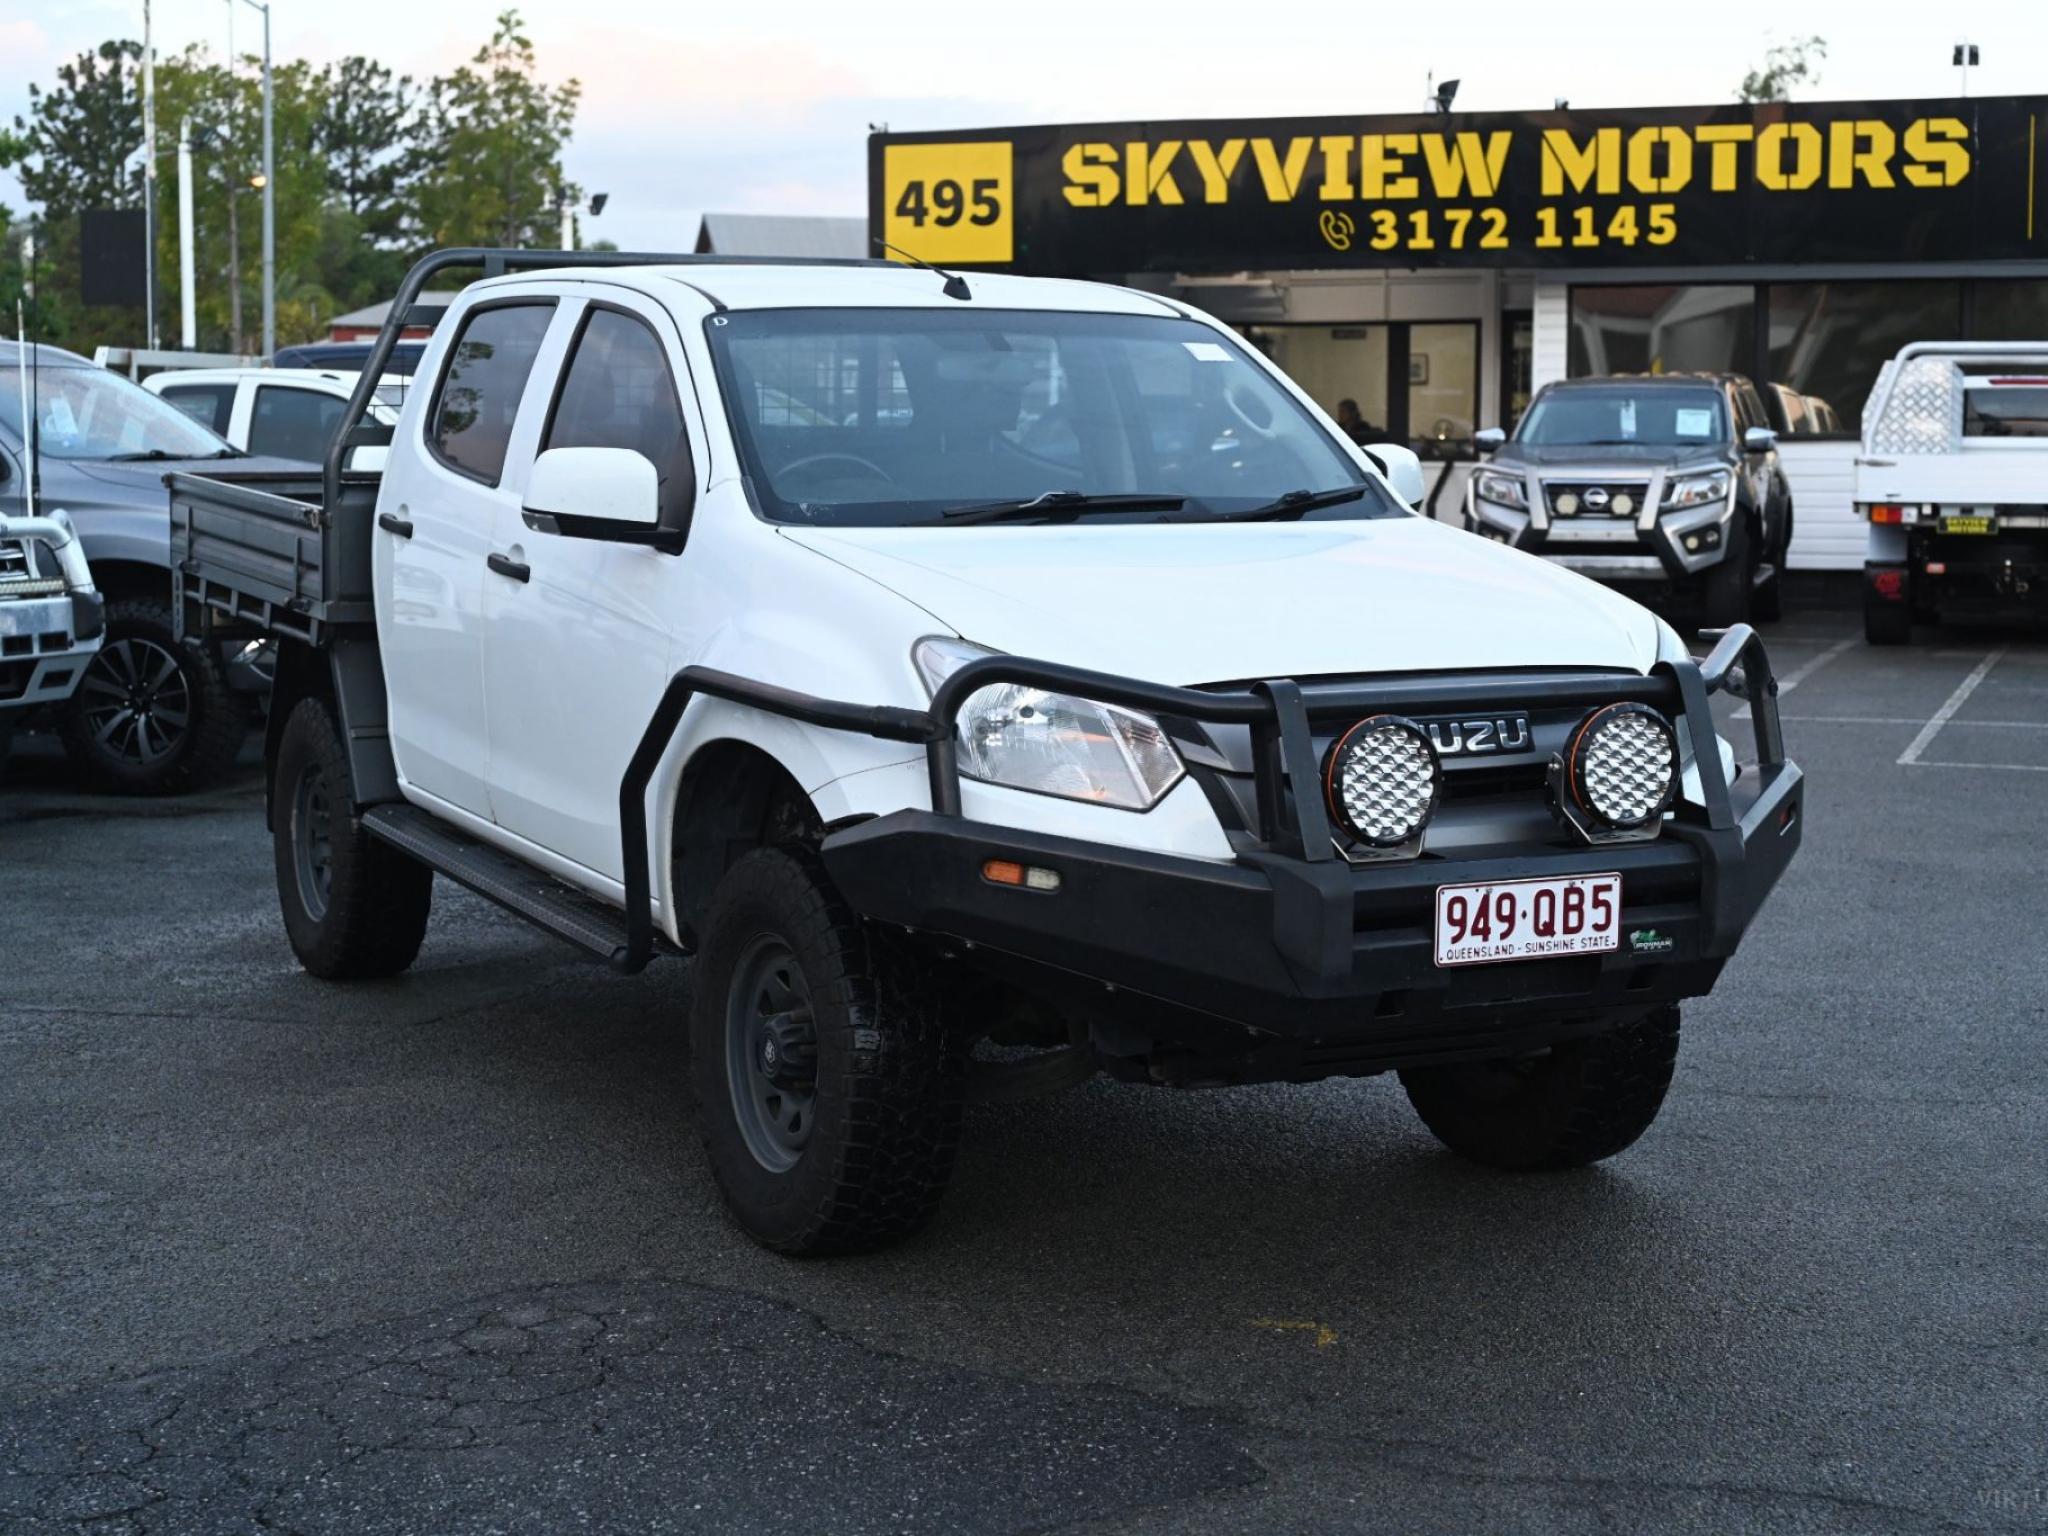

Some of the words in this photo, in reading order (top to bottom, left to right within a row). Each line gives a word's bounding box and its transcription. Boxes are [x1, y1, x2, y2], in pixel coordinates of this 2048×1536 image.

[1061, 130, 1513, 207] SKYVIEW
[1541, 117, 1970, 196] MOTORS
[896, 179, 1000, 227] 495
[1370, 207, 1509, 250] 3172
[1535, 203, 1677, 248] 1145
[1418, 718, 1528, 753] UZU
[1447, 945, 1514, 961] QUEENSLAND
[1525, 938, 1575, 953] SUNSHINE
[1580, 936, 1611, 948] STATE
